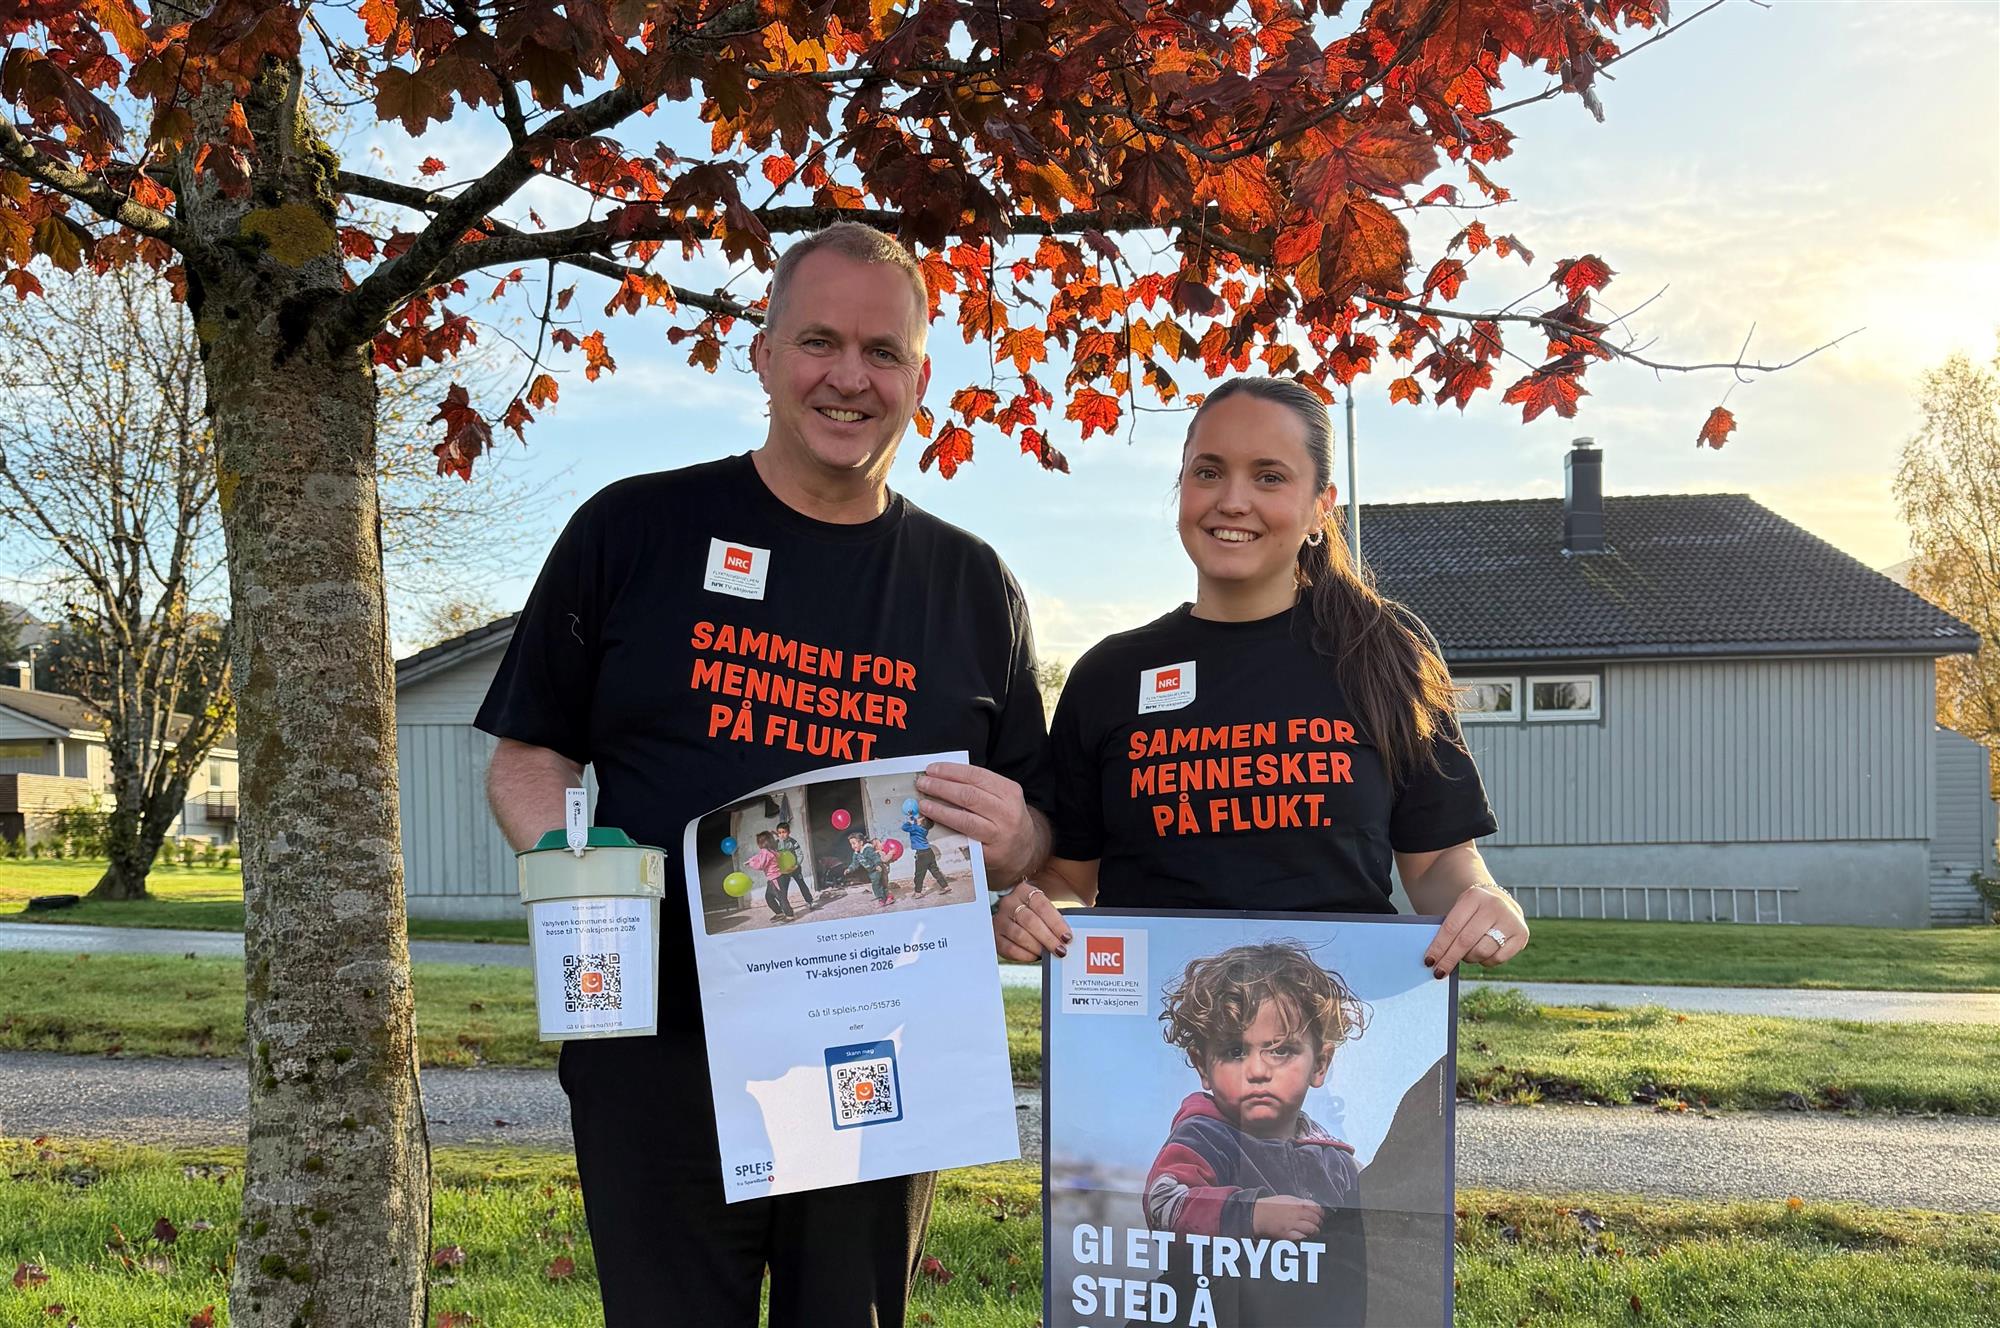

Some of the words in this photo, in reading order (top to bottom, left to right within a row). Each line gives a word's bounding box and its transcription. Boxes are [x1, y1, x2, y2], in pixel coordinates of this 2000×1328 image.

[727, 556, 750, 570] NRC
[691, 621, 843, 679] SAMMEN
[852, 653, 917, 691] FOR
[1158, 677, 1179, 689] NRC
[690, 658, 908, 730] MENNESKER
[708, 700, 754, 743] PÅ
[765, 714, 880, 763] FLUKT
[1128, 721, 1276, 760] SAMMEN
[1288, 717, 1359, 744] FOR
[1131, 751, 1354, 798] MENNESKER
[1152, 792, 1200, 837] PÅ
[1209, 794, 1331, 832] FLUKT.
[571, 917, 607, 926] kommune
[616, 916, 640, 925] digitale
[575, 925, 618, 934] TV-aksjonen
[816, 933, 838, 943] Støtt
[840, 929, 875, 940] spleisen
[746, 959, 793, 974] Vanylven
[795, 952, 847, 967] kommune
[850, 949, 858, 960] si
[860, 944, 901, 960] digitale
[903, 940, 936, 953] bøsse
[938, 937, 948, 949] til
[1089, 951, 1121, 967] NRC
[806, 963, 868, 980] TV-aksjonen
[870, 960, 894, 972] 2026
[1072, 979, 1139, 988] FLYKTNINGHJELPEN
[808, 1009, 820, 1018] Gå
[822, 1007, 830, 1016] til
[832, 999, 901, 1016] spleis.no/515736
[1091, 998, 1139, 1008] TV-aksjonen
[849, 1023, 864, 1031] eller
[1072, 1223, 1113, 1265] GI
[1126, 1228, 1176, 1271] ET
[1186, 1234, 1326, 1284] TRYGT
[1072, 1274, 1178, 1324] STED
[1188, 1275, 1218, 1328] Å
